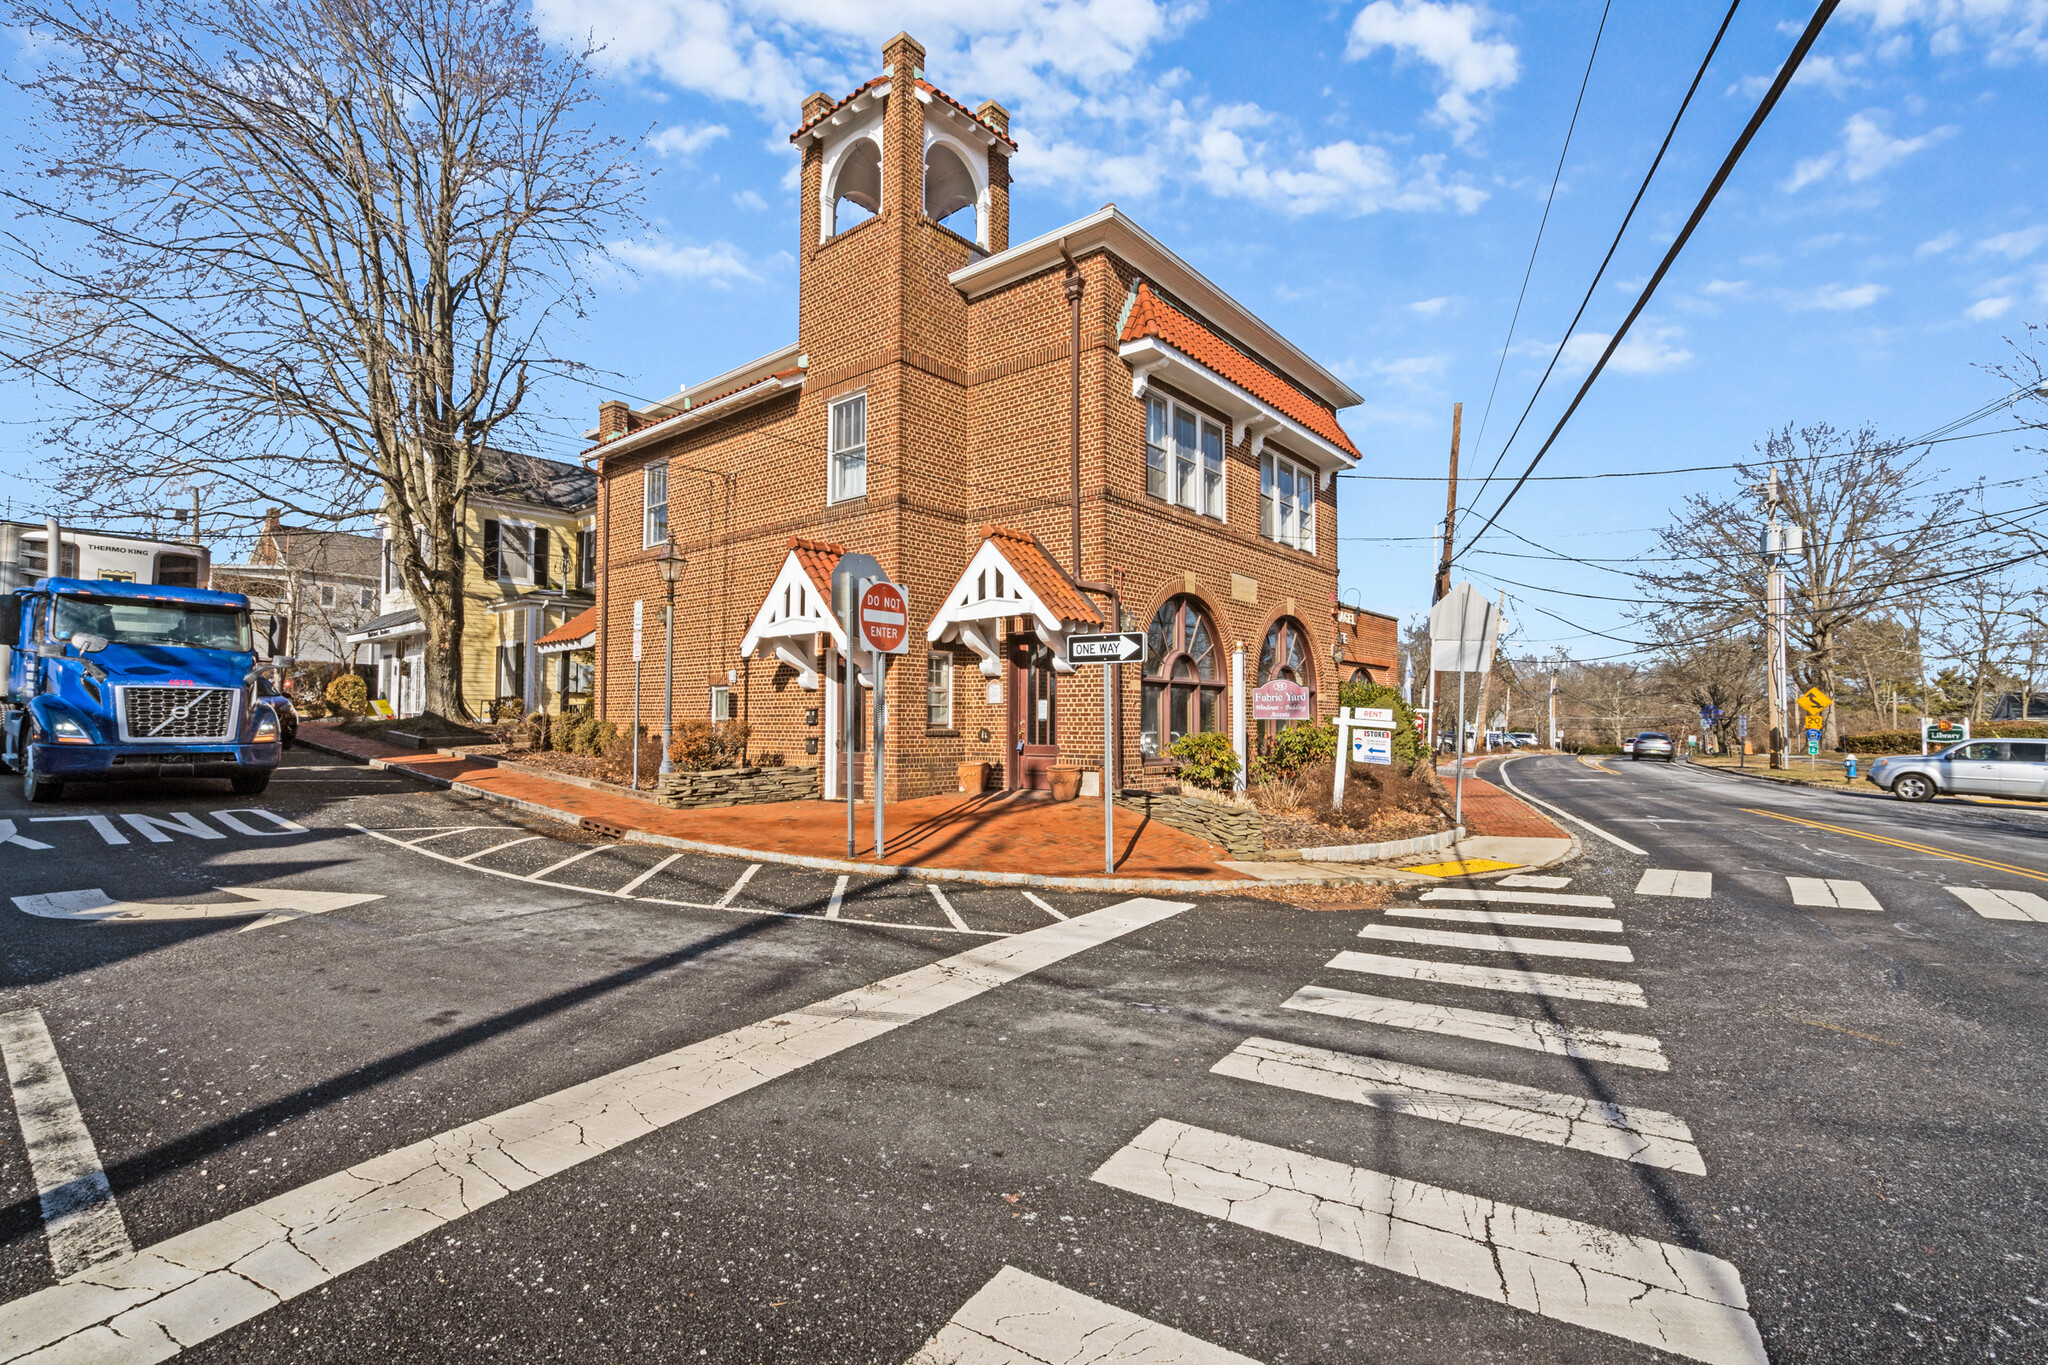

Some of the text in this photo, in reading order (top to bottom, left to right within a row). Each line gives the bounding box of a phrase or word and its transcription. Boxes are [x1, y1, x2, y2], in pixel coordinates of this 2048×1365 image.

[88, 544, 126, 554] THERMO
[867, 594, 901, 609] DO NOT
[870, 626, 898, 639] ENTER
[1076, 642, 1120, 655] ONE WAY
[1255, 692, 1306, 702] Fabric Yard
[1807, 716, 1821, 724] 20
